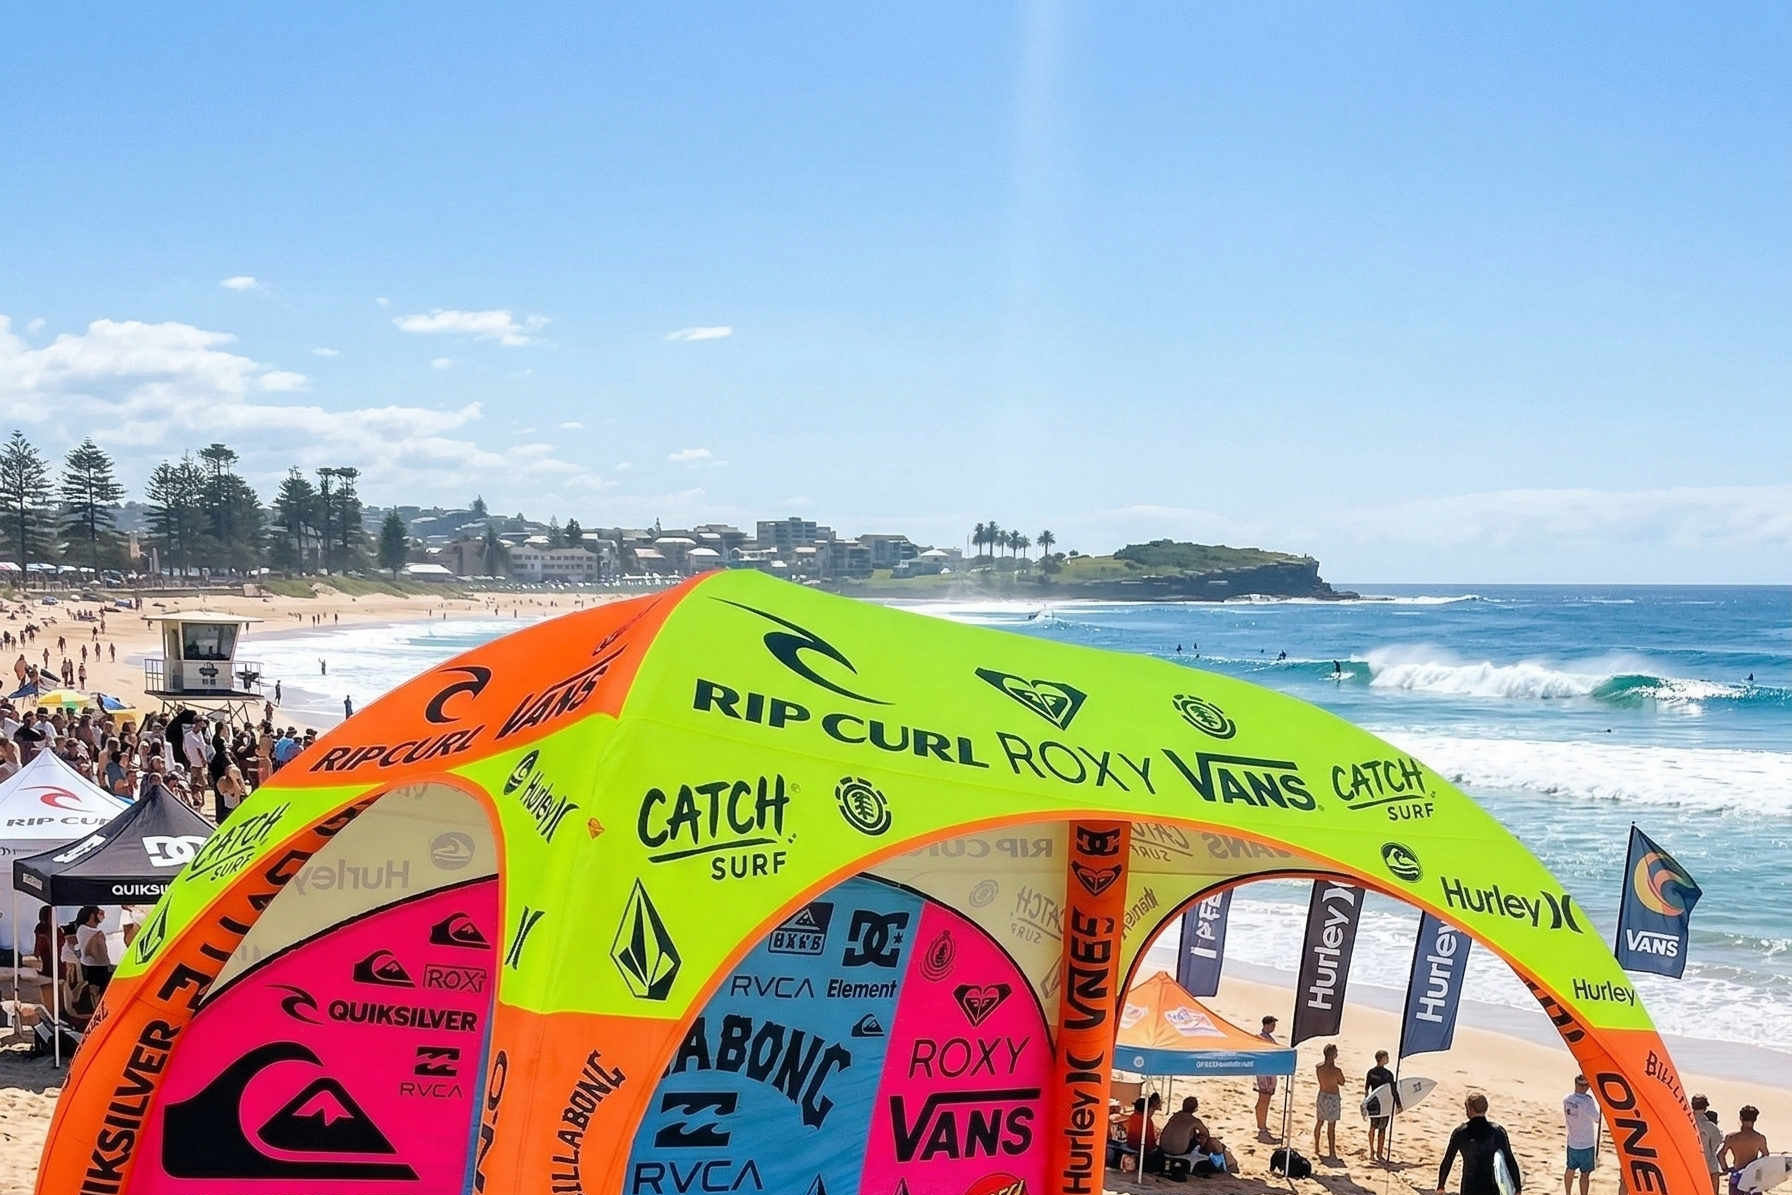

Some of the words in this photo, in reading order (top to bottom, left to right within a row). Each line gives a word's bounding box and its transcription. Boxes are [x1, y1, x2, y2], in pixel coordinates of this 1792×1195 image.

[494, 644, 628, 740] VANS
[693, 678, 811, 729] RIP
[821, 713, 990, 769] CURL
[996, 731, 1156, 796] ROXY
[1161, 748, 1316, 812] VANS
[1332, 758, 1426, 801] CATCH
[6, 817, 55, 827] RIP
[638, 774, 790, 847] CATCH
[1387, 803, 1434, 821] SURF
[190, 801, 291, 871] CATCH
[209, 852, 255, 881] SURF
[711, 851, 787, 880] SURF
[1440, 875, 1541, 928] Hurley
[1307, 902, 1350, 1010] Hurley
[1625, 929, 1680, 958] VANS
[730, 975, 815, 998] RVCA
[826, 978, 898, 999] Element
[1573, 978, 1635, 1007] Hurley
[328, 999, 478, 1032] QUIKSILVER
[908, 1036, 1031, 1079] ROXY
[400, 1082, 463, 1098] RVCA
[889, 1087, 1042, 1163] VANS
[1062, 1086, 1101, 1195] Hurley
[632, 1160, 764, 1195] RVCA
